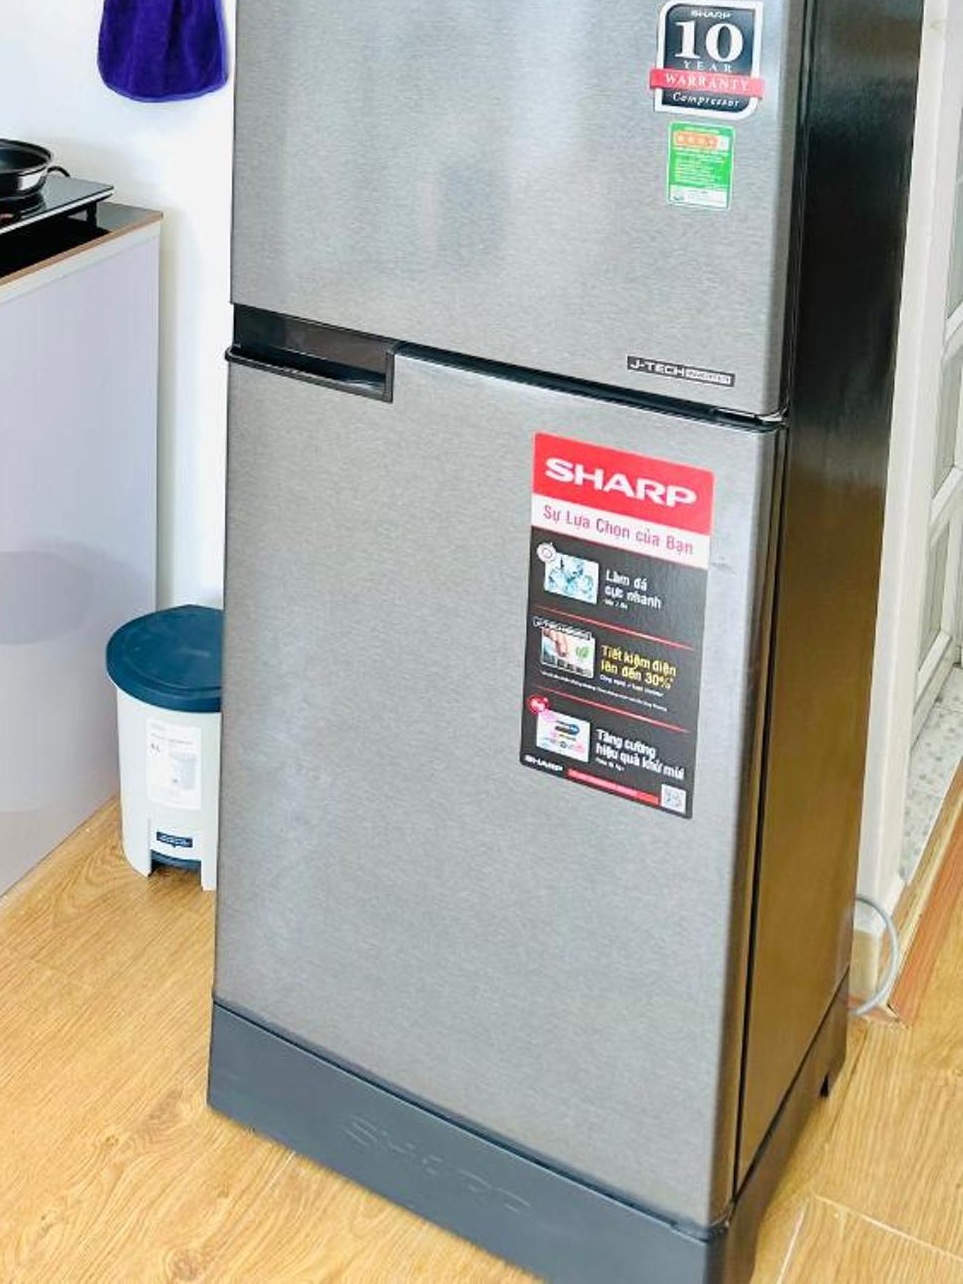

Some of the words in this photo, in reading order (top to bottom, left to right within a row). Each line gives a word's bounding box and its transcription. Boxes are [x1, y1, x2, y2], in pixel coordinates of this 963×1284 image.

[674, 20, 744, 63] 10
[683, 60, 733, 73] YEAR
[665, 72, 751, 92] WARRANTY
[672, 91, 741, 108] Compressor
[544, 457, 698, 508] SHARP
[543, 504, 562, 526] Sự
[566, 507, 591, 530] Lựa
[596, 518, 631, 540] Chọn
[636, 528, 661, 547] của
[666, 535, 694, 556] Bạn
[626, 590, 663, 610] nhanh
[600, 644, 623, 661] Tiết
